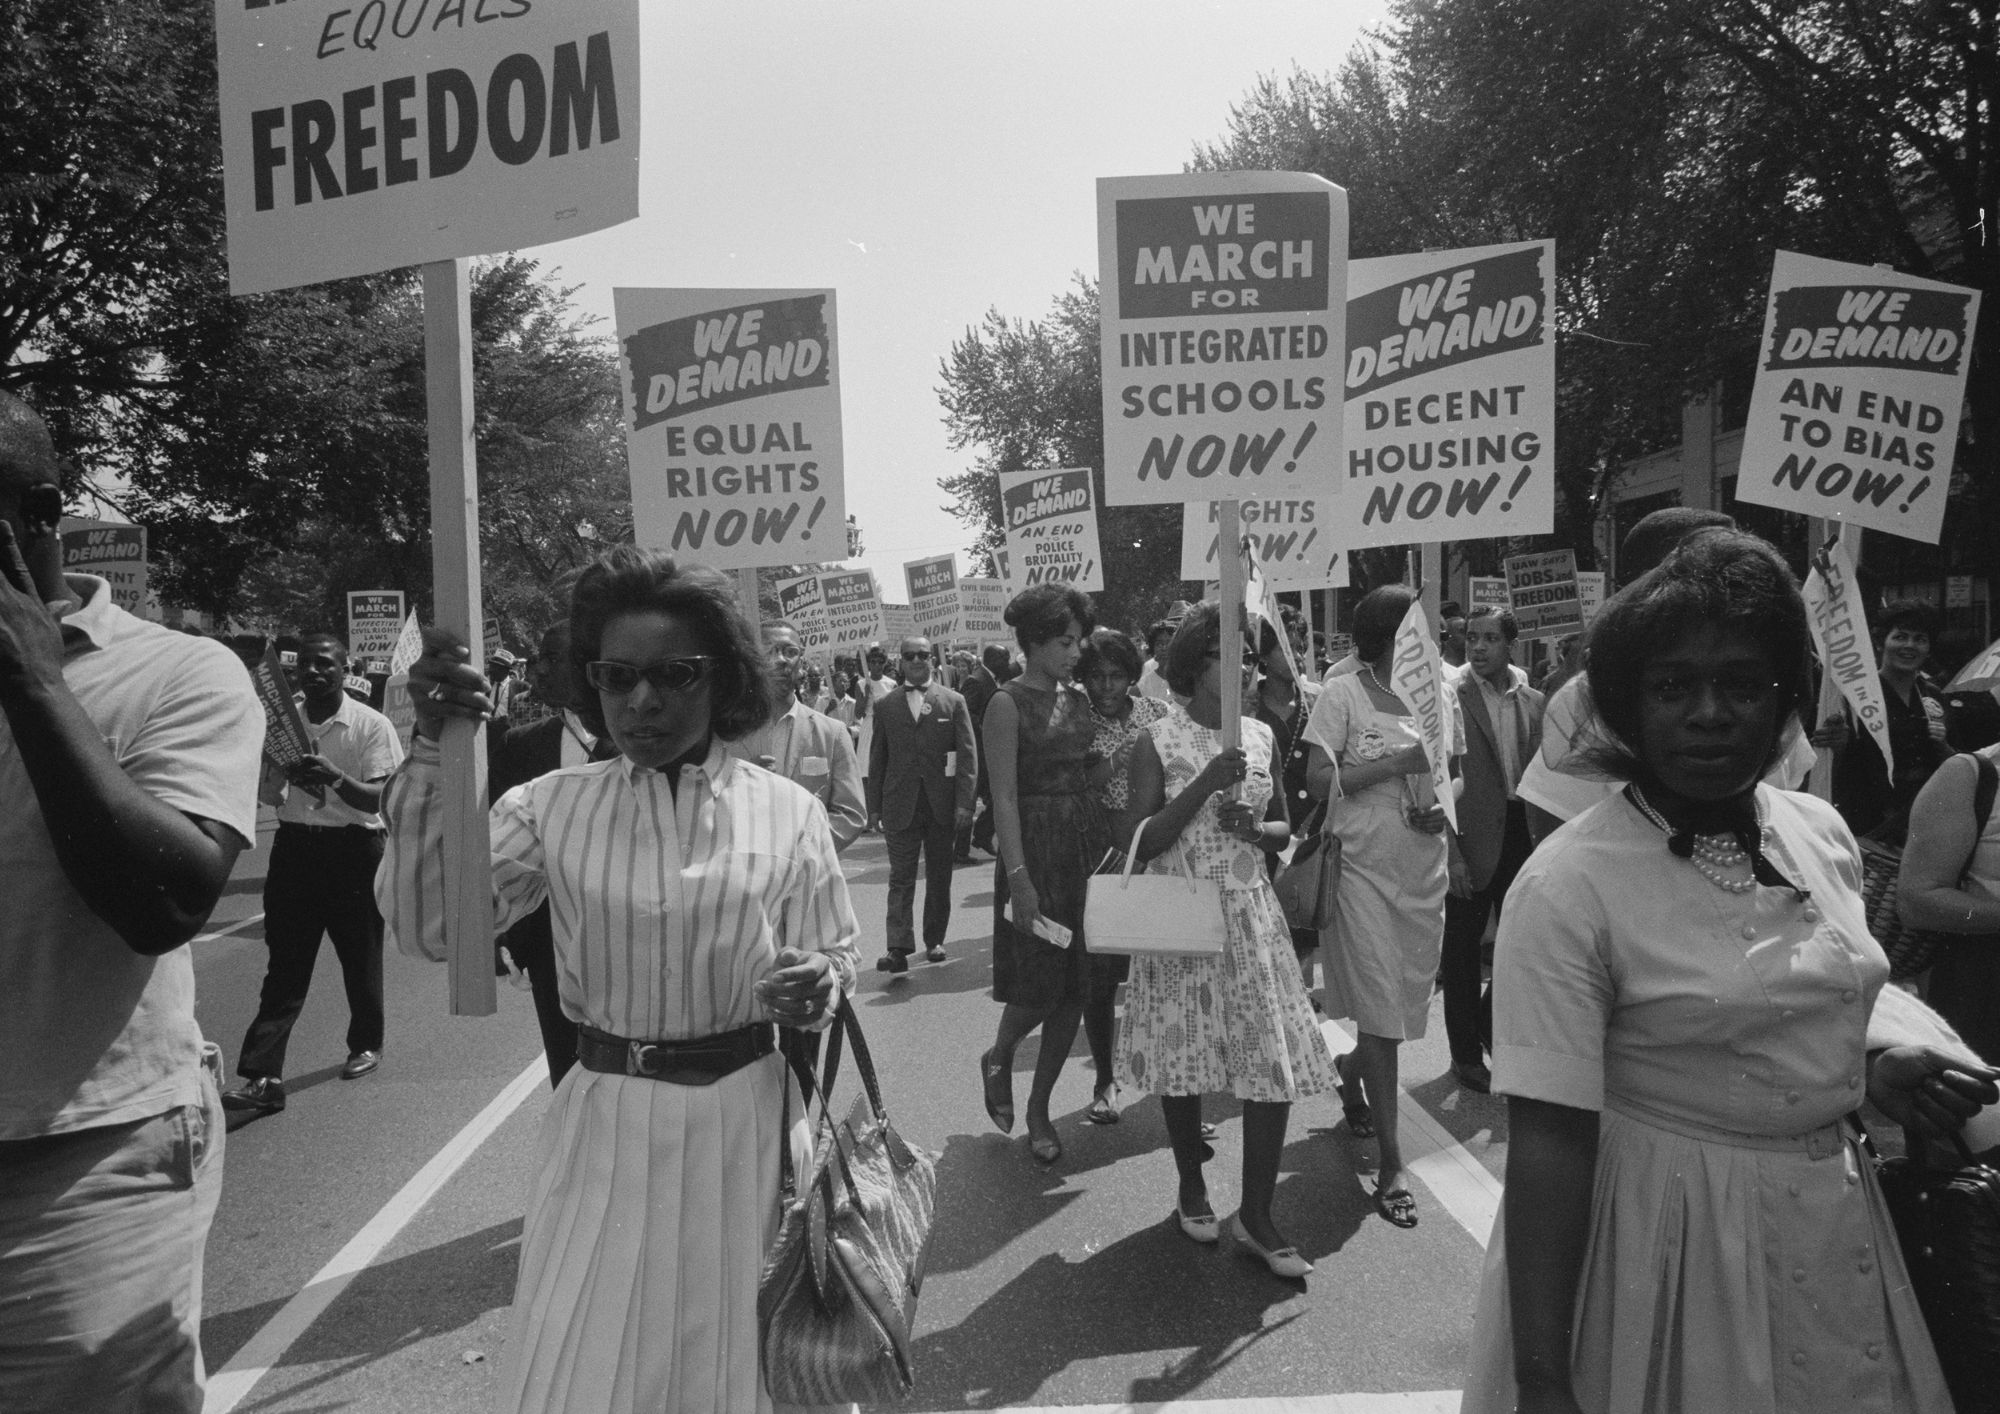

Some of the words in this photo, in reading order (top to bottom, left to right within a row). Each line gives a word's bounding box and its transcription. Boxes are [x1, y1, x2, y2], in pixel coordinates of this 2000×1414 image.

[251, 30, 620, 212] FREEDOM
[1192, 203, 1255, 236] WE
[1134, 240, 1314, 285] MARCH
[1191, 289, 1261, 308] FOR
[1398, 269, 1476, 326] WE
[1836, 290, 1911, 323] WE
[693, 309, 764, 358] WE
[1346, 295, 1537, 388] DEMAND
[1779, 326, 1958, 362] DEMAND
[1120, 324, 1328, 368] INTEGRATED
[646, 338, 822, 414] DEMAND
[1121, 376, 1327, 419] SCHOOLS
[1364, 385, 1526, 431] DECENT
[1779, 377, 1844, 414] AN
[1857, 390, 1944, 434] END
[666, 422, 812, 457] EQUAL
[1779, 413, 1832, 448] TO
[1843, 426, 1936, 472] BIAS
[1137, 420, 1318, 482] NOW!
[1348, 431, 1541, 478] HOUSING
[666, 461, 819, 498] RIGHTS
[1032, 476, 1063, 499] WE
[1771, 453, 1931, 513] NOW!
[1362, 464, 1533, 526] NOW!
[1013, 488, 1086, 525] DEMAND
[1208, 500, 1316, 524] RGHTS
[670, 495, 826, 550] NOW!
[1020, 526, 1046, 539] AN
[1051, 524, 1083, 536] END
[88, 530, 118, 545] WE
[1035, 541, 1075, 553] POLICE
[68, 543, 139, 563] DEMAND
[1025, 552, 1083, 566] BRUTALITY
[925, 564, 938, 575] WE
[1026, 559, 1093, 586] NOW!
[1512, 560, 1537, 570] UAW
[797, 579, 815, 595] WE
[838, 576, 855, 586] WE
[913, 571, 951, 589] MARCH
[961, 584, 978, 592] CIVIL
[980, 584, 1003, 593] RIGHTS
[1512, 569, 1553, 588] JOBS
[787, 590, 820, 612] DEMA
[828, 583, 869, 598] MARCH
[1513, 585, 1577, 607] FREEDOM
[355, 604, 396, 613] MARCH
[827, 601, 877, 617] INTEGRATED
[913, 600, 935, 612] FIRST
[936, 593, 958, 606] CLASS
[972, 598, 990, 606] FULL
[792, 611, 807, 620] AN
[811, 608, 824, 616] EN
[830, 613, 879, 628] SCHOOLS
[913, 604, 960, 623] CITIZENSHIP
[837, 623, 879, 643] NOW!
[922, 617, 959, 638] NOW!
[965, 620, 1002, 631] REEDOM
[356, 641, 398, 652] NOW!
[258, 661, 282, 707] MARCH
[1393, 626, 1440, 745] FREEDOM
[1855, 686, 1868, 701] IN
[1860, 700, 1884, 733] '63
